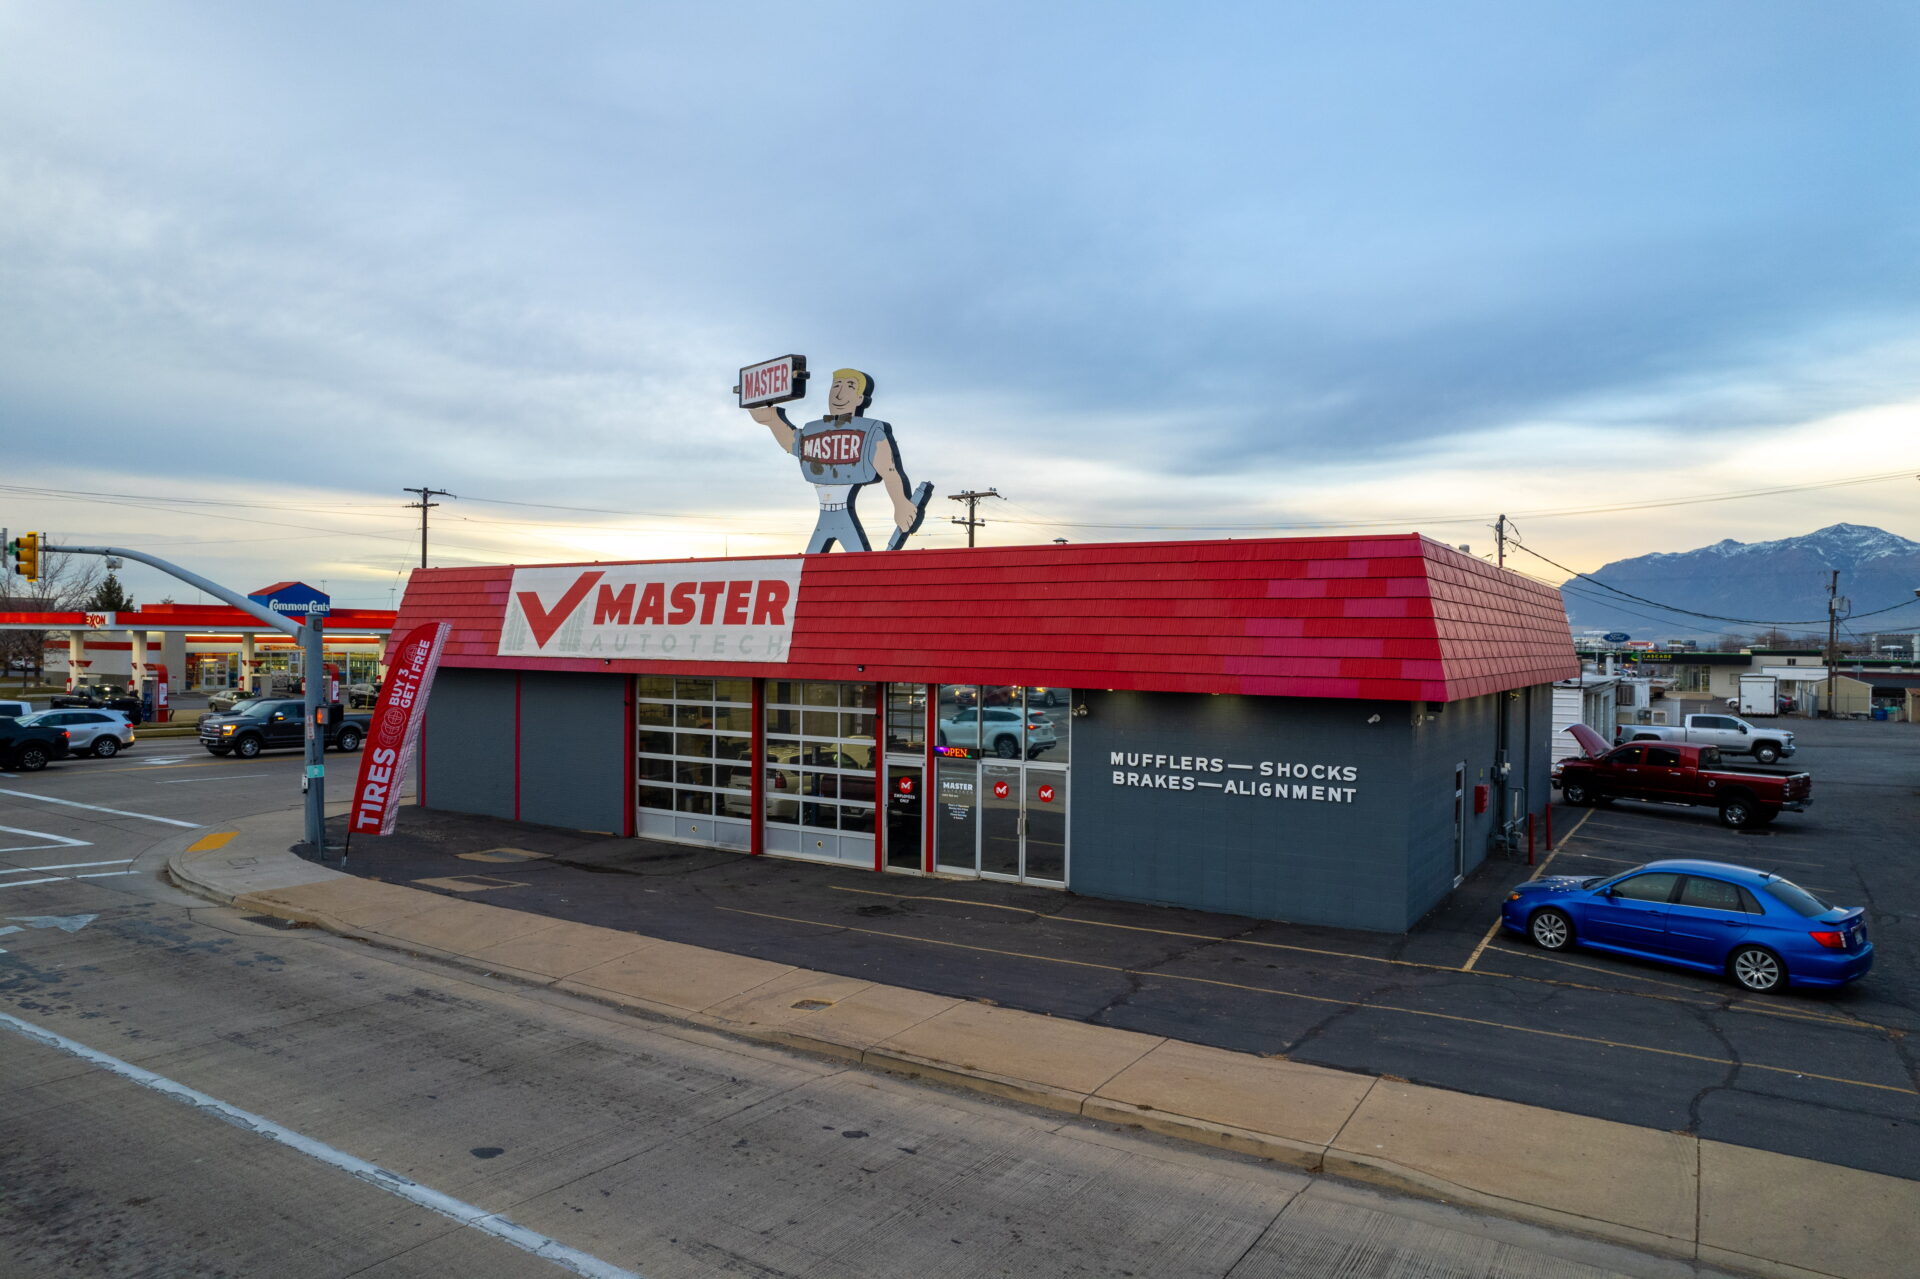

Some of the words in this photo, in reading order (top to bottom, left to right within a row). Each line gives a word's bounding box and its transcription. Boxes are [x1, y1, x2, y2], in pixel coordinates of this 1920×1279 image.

[745, 363, 789, 400] MASTER
[803, 434, 861, 460] MASTER
[268, 599, 308, 613] Common
[308, 600, 330, 613] Cents
[592, 579, 791, 627] MASTER
[86, 613, 106, 629] EXXON
[589, 633, 785, 656] AUTOTECH
[388, 678, 405, 706] BUY
[398, 668, 409, 677] 3
[400, 682, 416, 708] GET
[411, 639, 430, 673] FREE
[943, 747, 968, 758] OPEN
[1110, 751, 1224, 773] MUFFLERS
[1259, 761, 1358, 782] SHOCKS
[357, 747, 396, 829] TIRES
[943, 782, 973, 791] MASTER
[1112, 771, 1195, 791] BRAKES
[1224, 780, 1357, 803] ALIGNMENT
